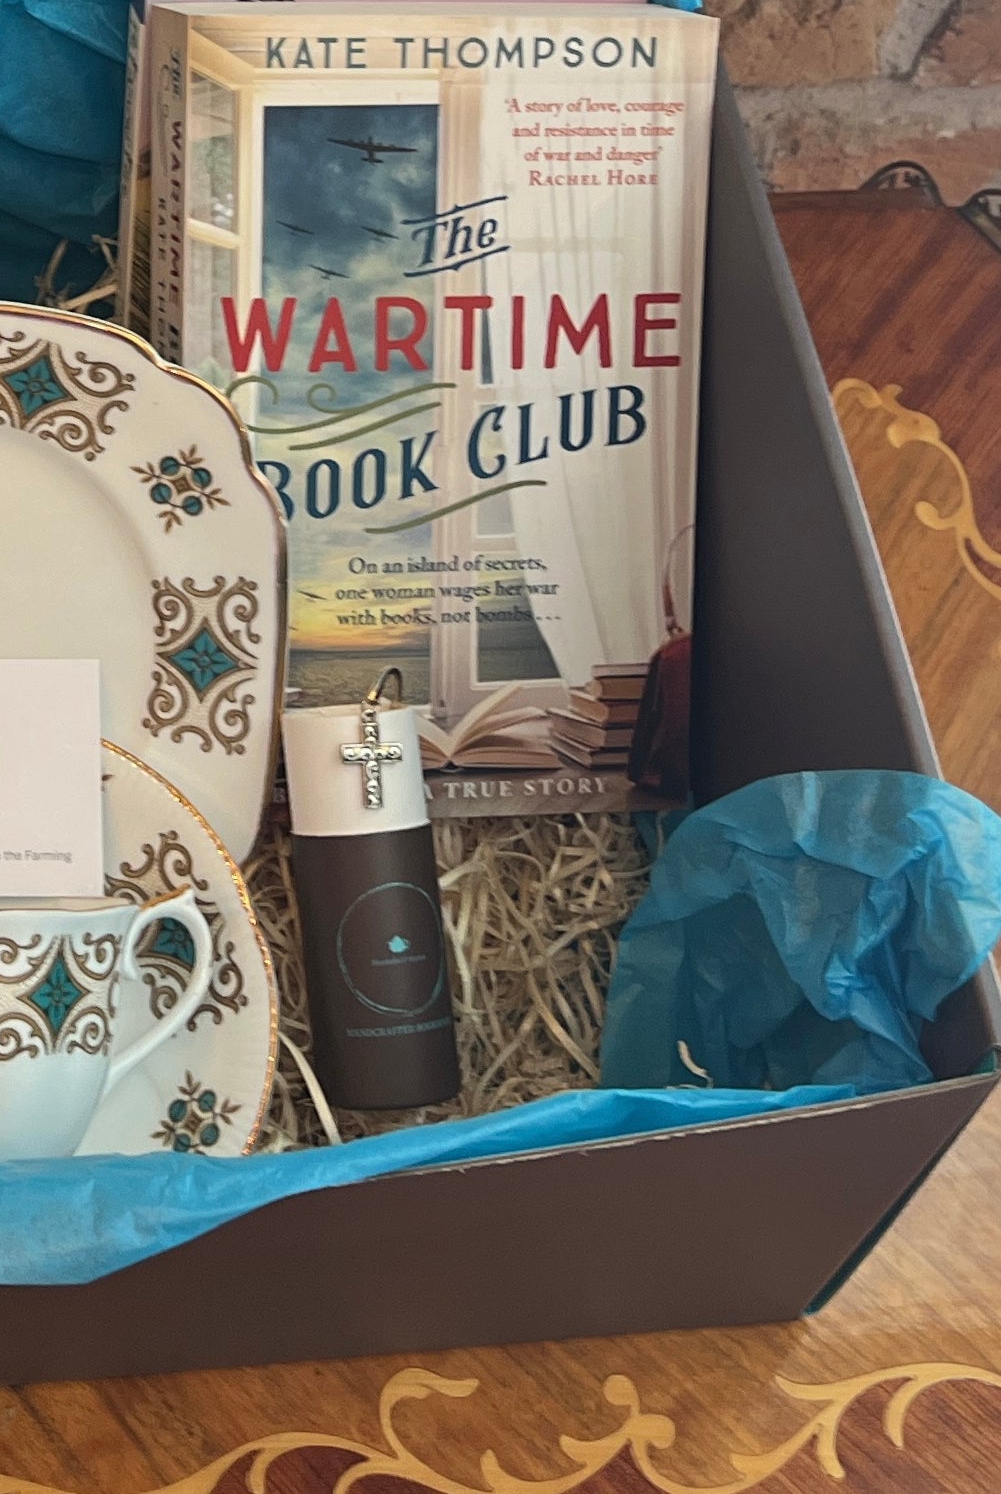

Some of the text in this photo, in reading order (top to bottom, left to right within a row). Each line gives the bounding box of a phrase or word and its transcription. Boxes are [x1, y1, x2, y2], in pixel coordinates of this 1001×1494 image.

[266, 37, 658, 68] KATE THOMPSON
[525, 102, 563, 117] story
[567, 99, 587, 112] of
[586, 98, 621, 113] love,
[624, 101, 686, 116] courage
[512, 123, 675, 137] and resistance in time
[524, 147, 543, 161] of
[544, 151, 571, 162] war
[575, 147, 602, 161] and
[411, 217, 498, 267] The
[221, 293, 682, 373] WARTIME
[256, 384, 647, 523] BOOK CLUB
[349, 555, 548, 574] On an island of secrets,
[336, 580, 559, 603] one woman wages her war
[337, 609, 376, 625] with
[381, 609, 437, 625] books,
[441, 610, 471, 623] not
[443, 780, 513, 799] TRUE
[522, 776, 608, 797] STORY
[3, 850, 21, 860] the
[24, 849, 73, 864] Farming
